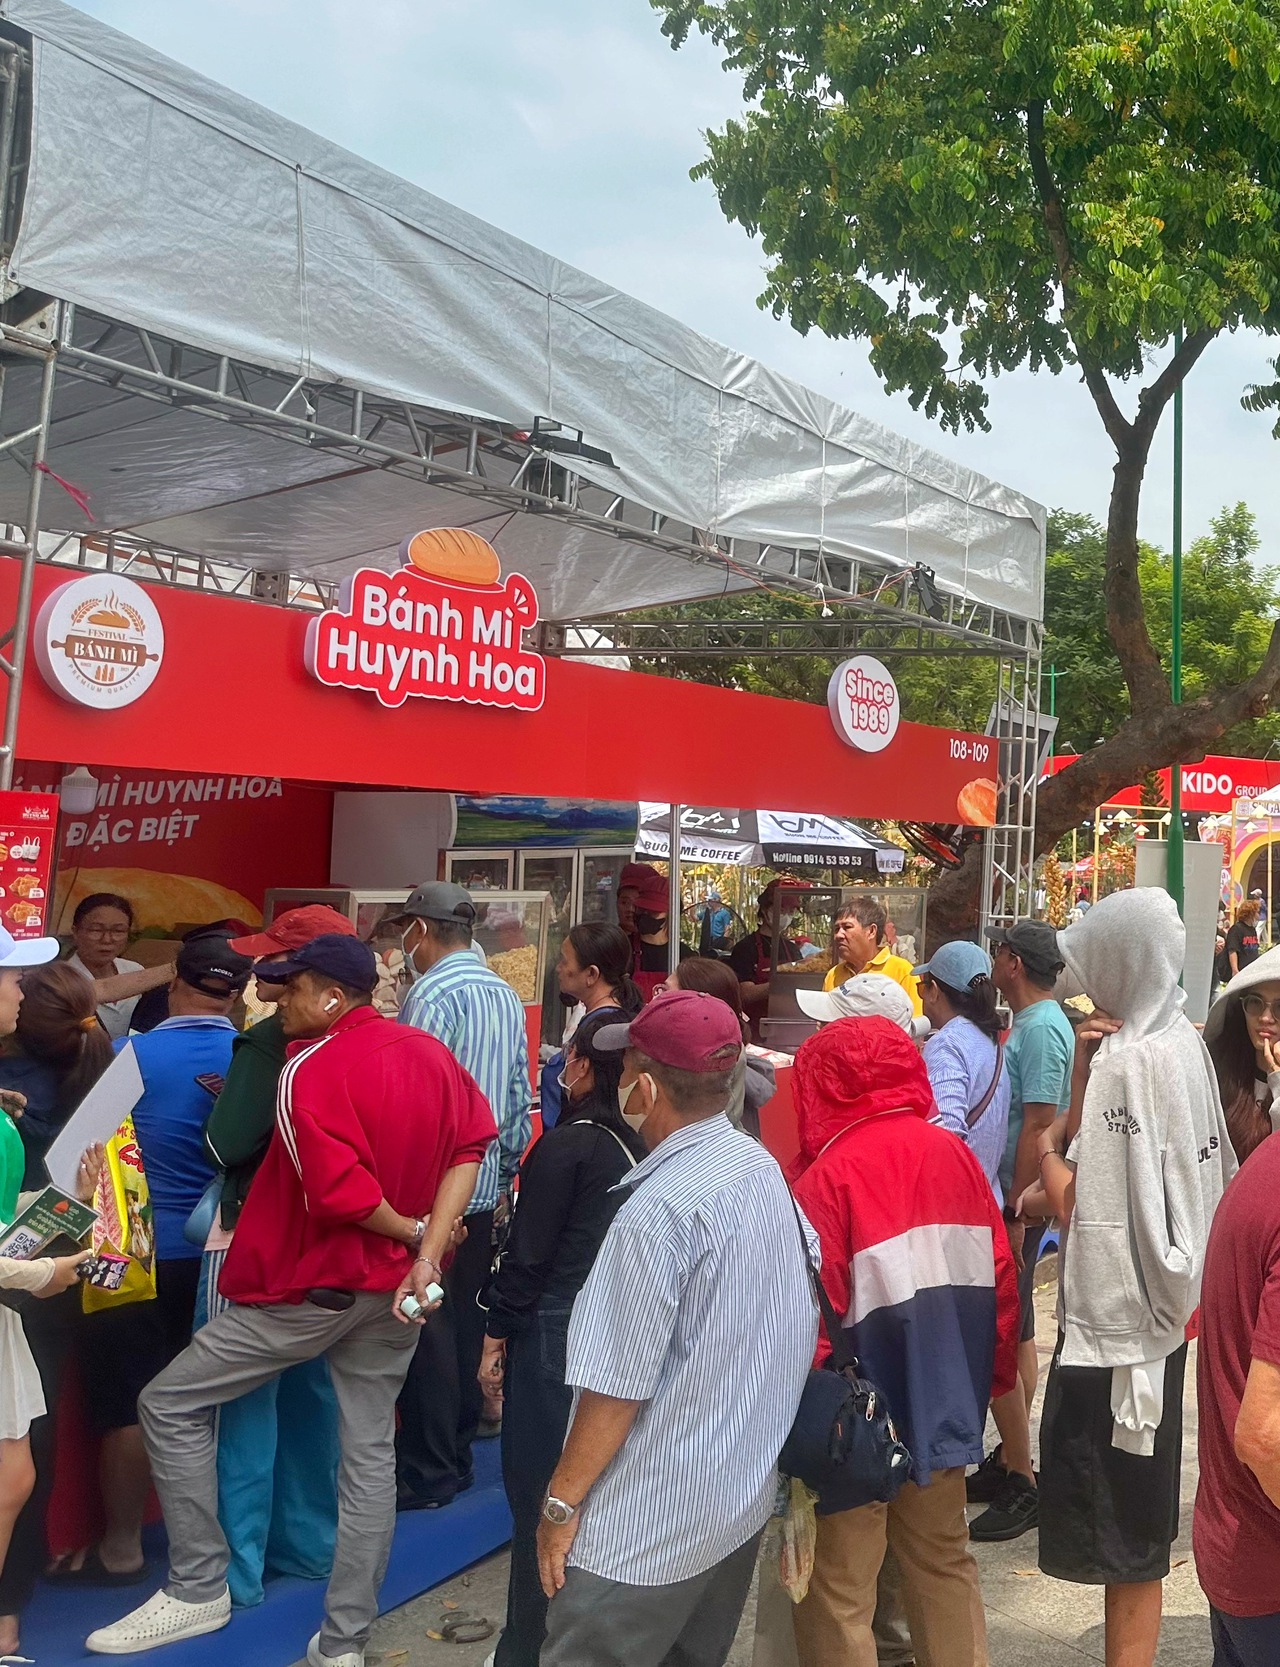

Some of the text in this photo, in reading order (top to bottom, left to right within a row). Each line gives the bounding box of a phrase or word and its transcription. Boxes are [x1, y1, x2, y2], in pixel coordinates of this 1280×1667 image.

[363, 584, 514, 649] Bánh Mì
[88, 628, 128, 641] FESTIVAL
[74, 641, 138, 663] BÁNH MÌ
[328, 627, 536, 696] Huynh Hoa
[68, 664, 141, 694] PREMIUM QUALITY
[846, 668, 894, 707] Since
[851, 701, 890, 735] 1989
[950, 738, 989, 763] 108-109
[122, 778, 224, 806] HUYNH
[1182, 771, 1233, 795] KIDO
[66, 808, 200, 851] ĐẶC BIỆT
[644, 840, 670, 853] BUÔ
[700, 848, 741, 861] COFFEE
[803, 853, 824, 865] 0914
[826, 855, 837, 865] 53
[838, 855, 850, 866] 53
[851, 856, 862, 866] 53
[210, 967, 234, 978] LACOSTE
[1108, 1122, 1130, 1135] STU
